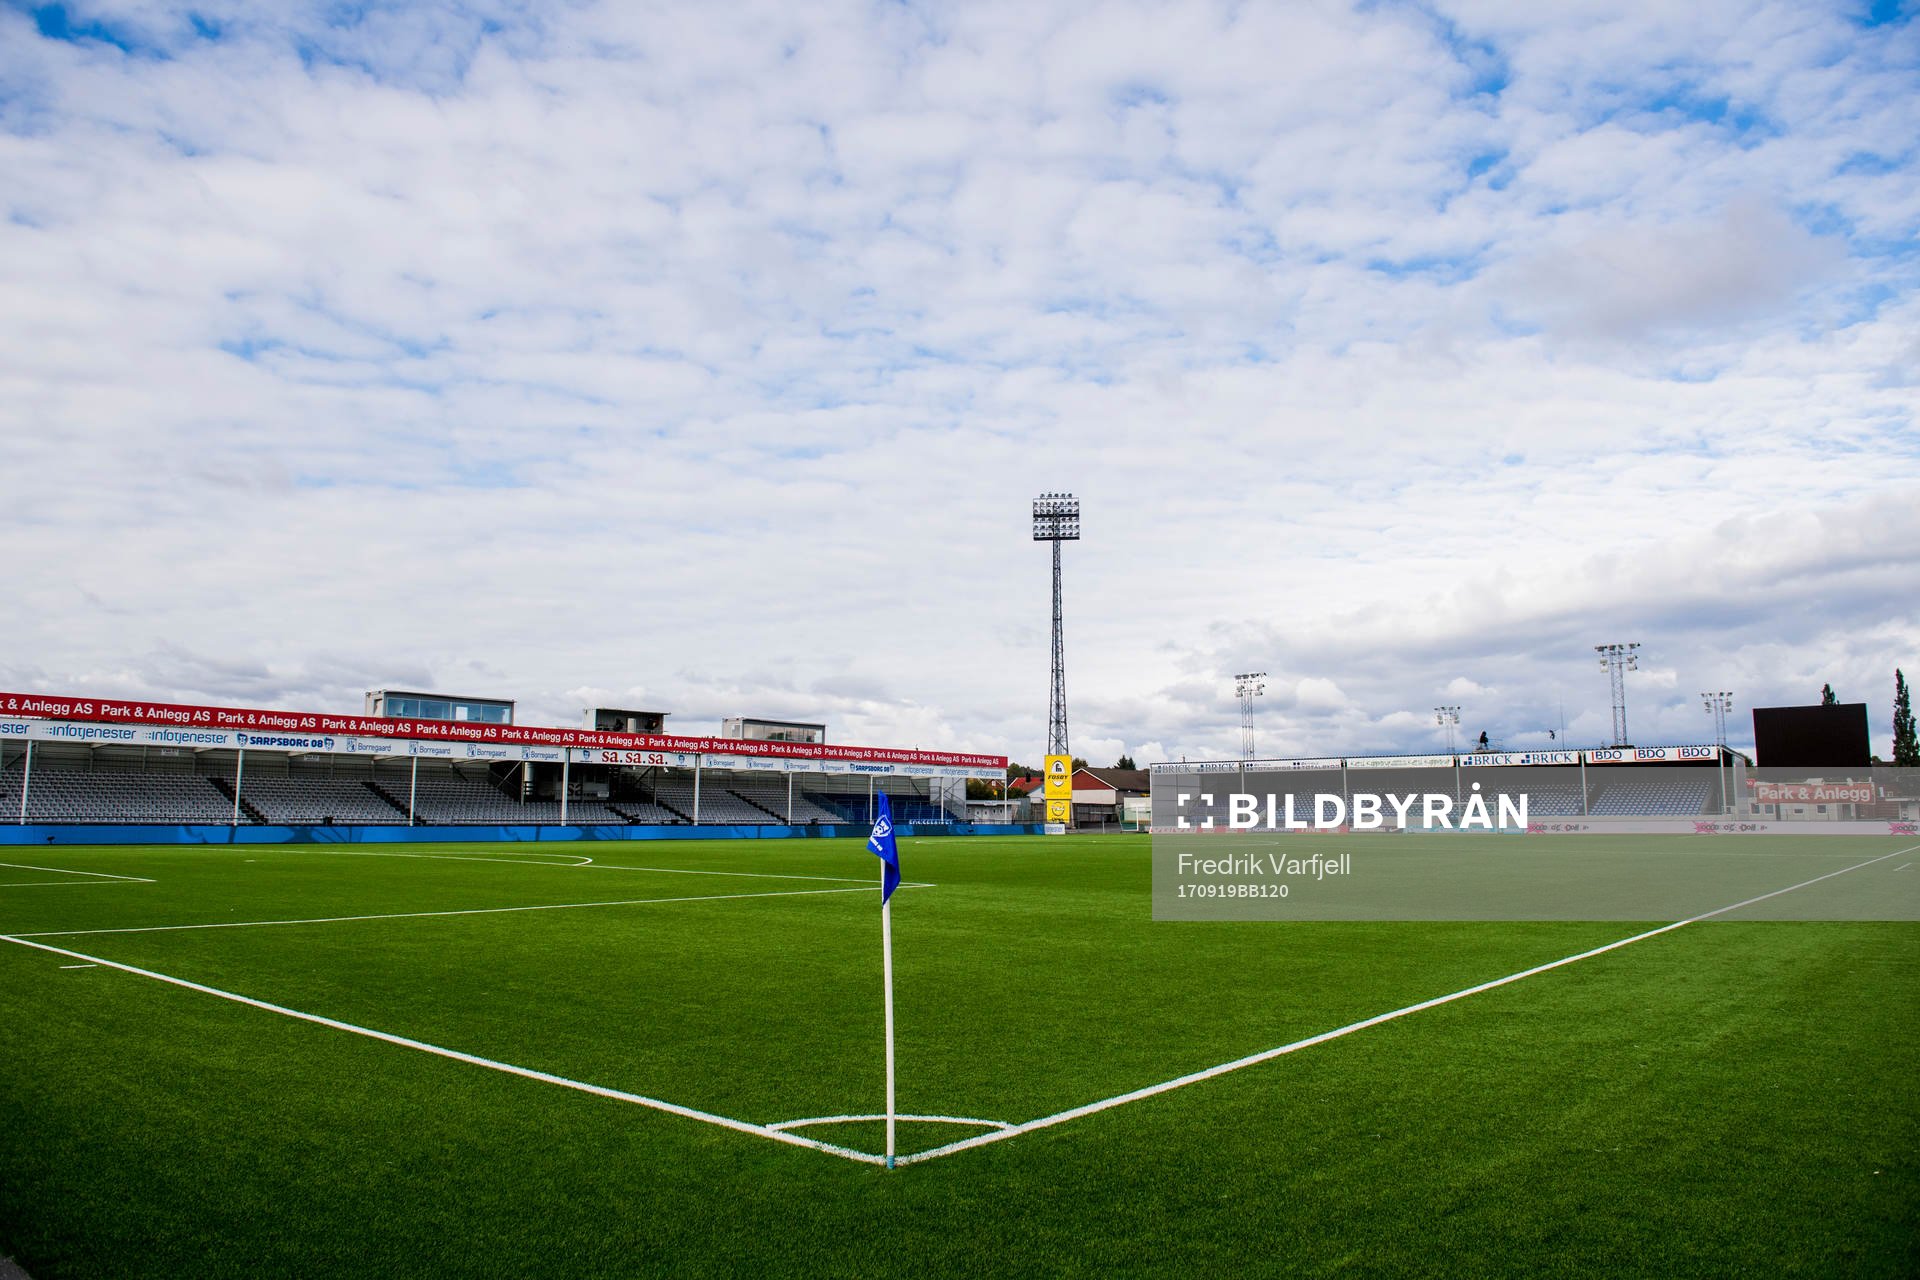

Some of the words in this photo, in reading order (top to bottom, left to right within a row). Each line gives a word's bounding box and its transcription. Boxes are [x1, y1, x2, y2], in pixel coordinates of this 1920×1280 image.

[8, 699, 18, 710] &
[22, 700, 70, 716] Anlegg
[73, 703, 93, 714] AS
[101, 704, 130, 716] Park
[134, 706, 143, 717] &
[147, 708, 190, 722] Anlegg
[193, 711, 210, 721] AS
[218, 712, 244, 723] Park
[248, 714, 256, 724] &
[259, 714, 297, 728] Anlegg
[300, 718, 316, 727] AS
[52, 724, 136, 740] infotjenester
[322, 719, 346, 729] Park
[349, 720, 356, 730] &
[359, 721, 394, 734] Anlegg
[396, 723, 411, 732] AS
[416, 724, 438, 734] Park
[440, 726, 447, 734] &
[450, 726, 482, 738] Anlegg
[484, 728, 497, 737] AS
[152, 729, 228, 744] infotjenester
[502, 729, 521, 739] Park
[523, 731, 530, 739] &
[532, 731, 561, 742] Anlegg
[562, 733, 574, 742] AS
[578, 734, 597, 743] Park
[598, 735, 604, 744] &
[606, 736, 632, 746] Anlegg
[250, 736, 309, 747] SARPSBORG
[311, 740, 323, 748] 08
[358, 742, 391, 753] Borregaard
[649, 738, 665, 747] Park
[674, 740, 698, 750] Anlegg
[713, 742, 728, 750] Park
[736, 743, 758, 752] Anlegg
[420, 746, 450, 755] Borregaard
[477, 749, 506, 758] Borregaard
[792, 746, 812, 755] Anlegg
[1595, 751, 1622, 759] BDO
[1638, 749, 1666, 758] BDO
[1682, 748, 1710, 757] BDO
[1474, 755, 1512, 765] BRICK
[1532, 753, 1572, 764] BRICK
[1162, 765, 1192, 773] BRICK
[1205, 763, 1235, 772] BRICK
[1758, 787, 1794, 800] Park
[1798, 787, 1810, 800] &
[1814, 788, 1871, 802] Anlegg
